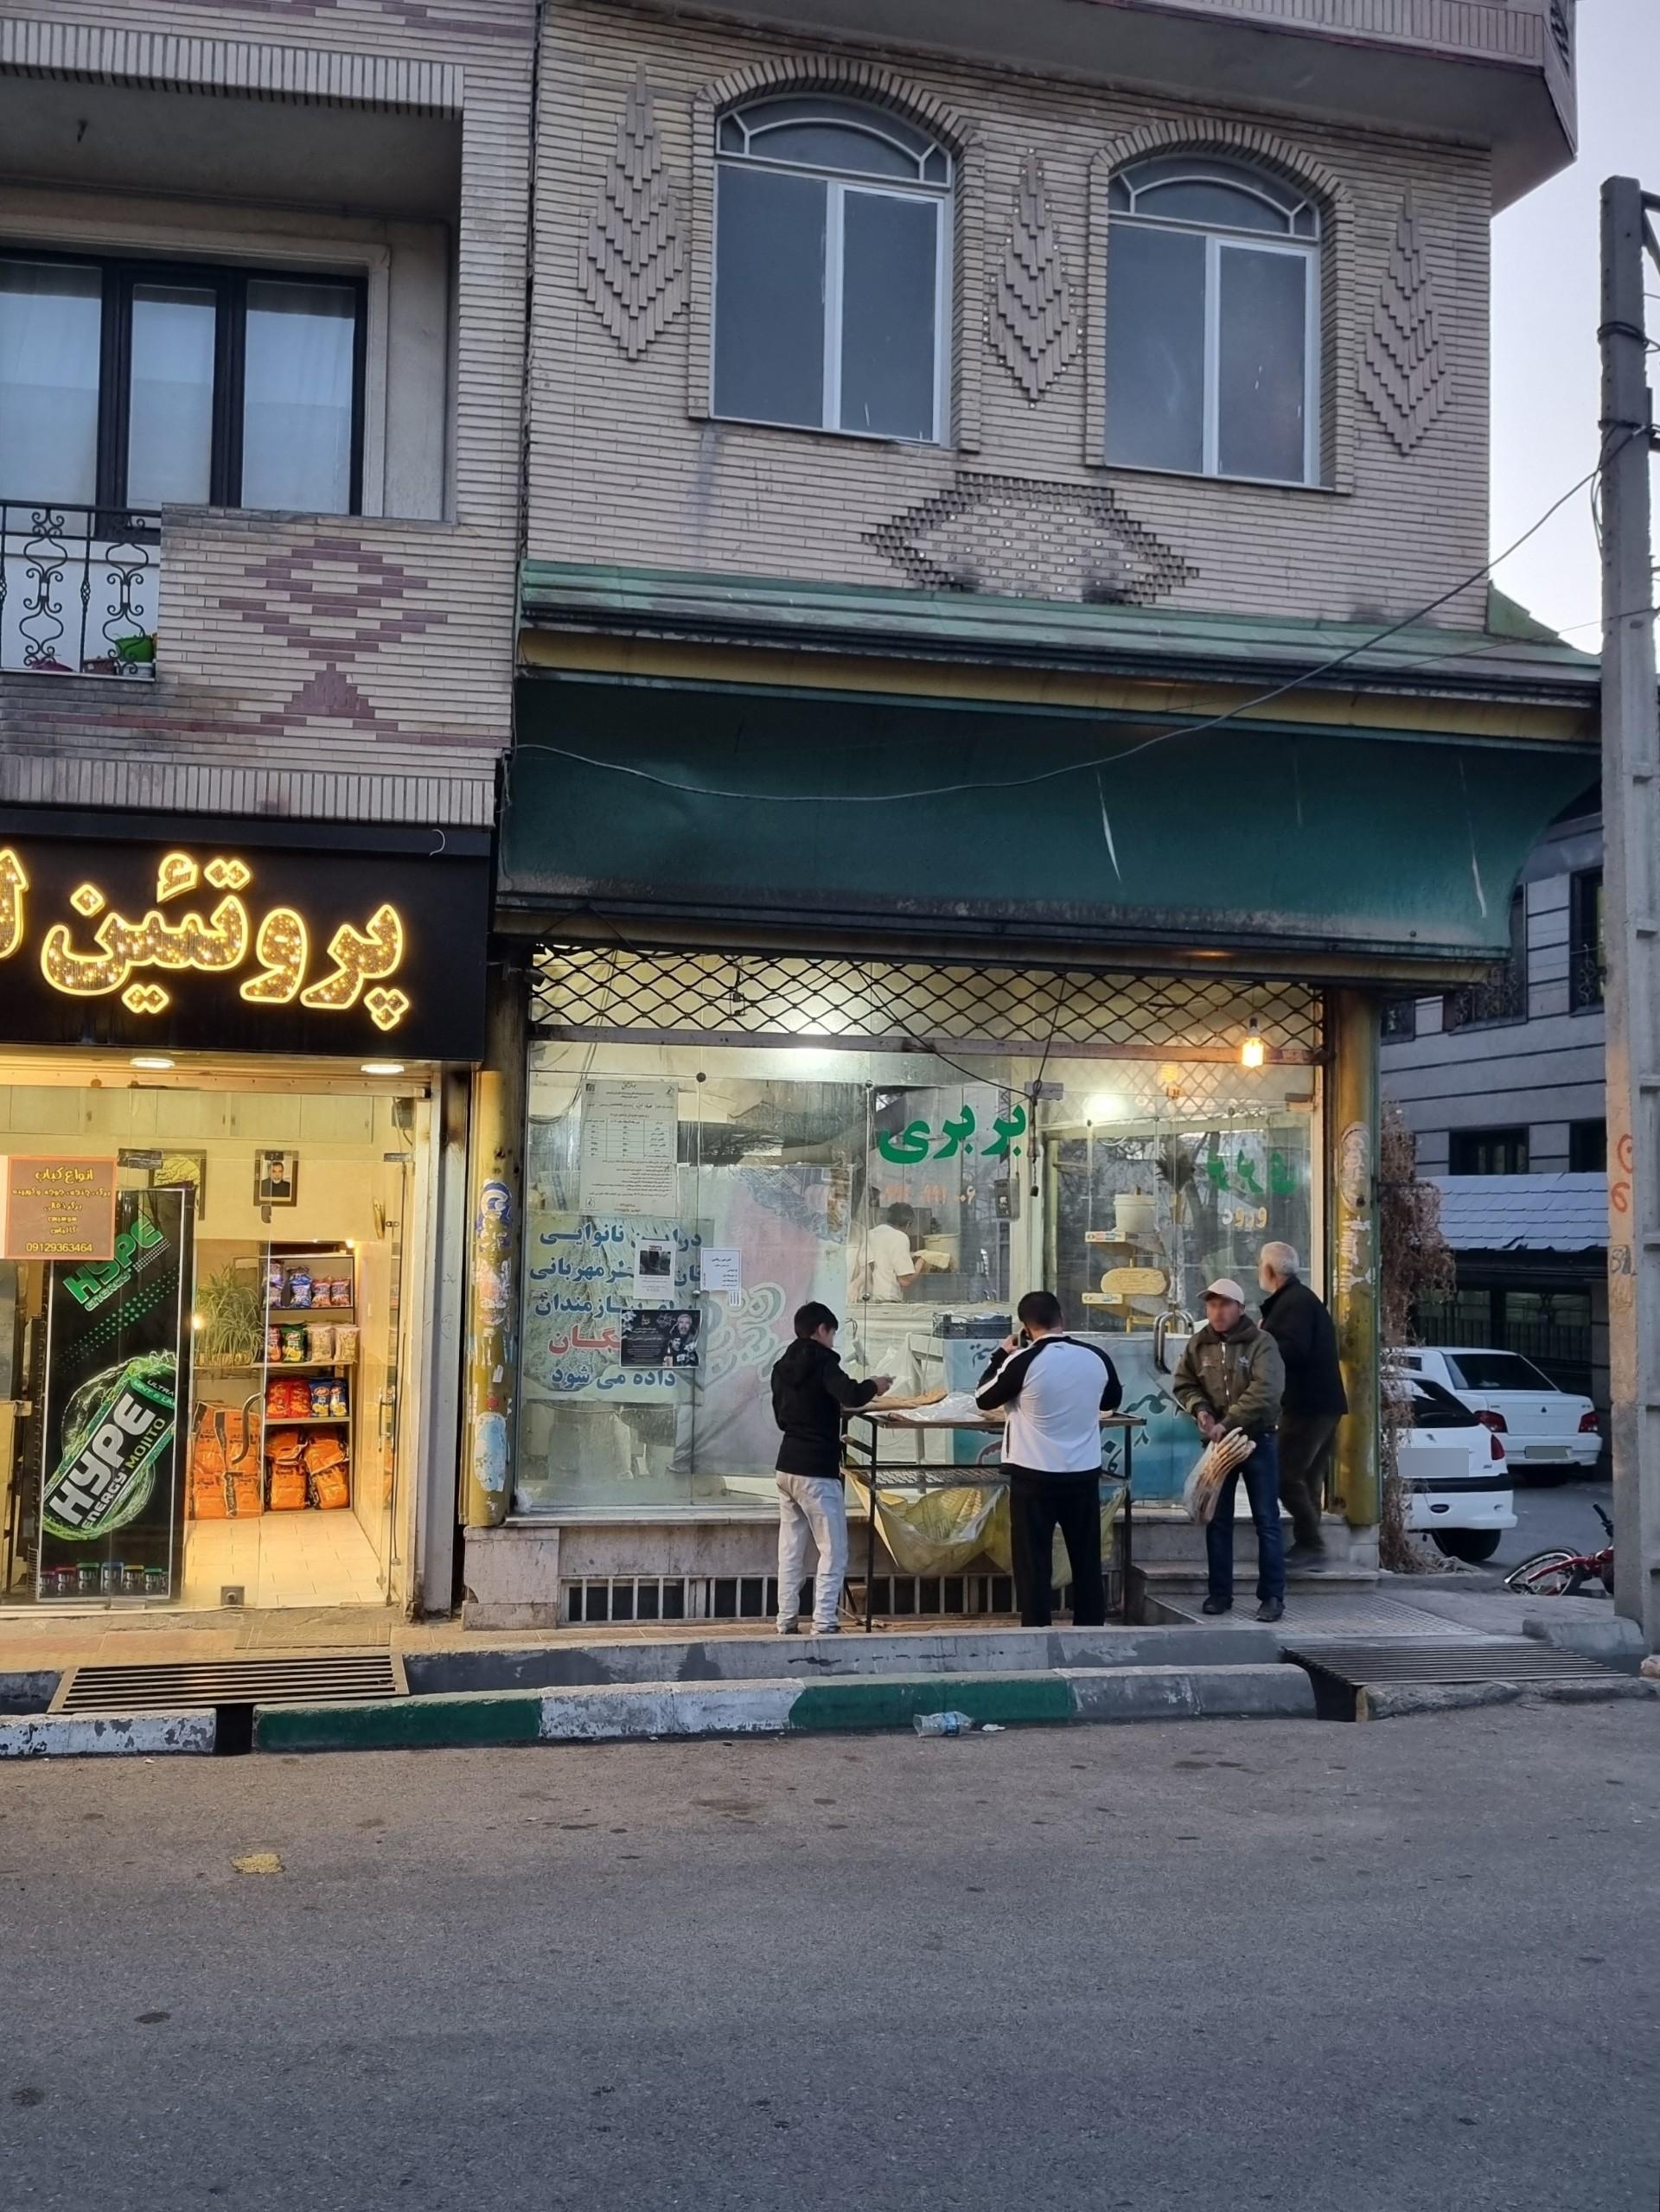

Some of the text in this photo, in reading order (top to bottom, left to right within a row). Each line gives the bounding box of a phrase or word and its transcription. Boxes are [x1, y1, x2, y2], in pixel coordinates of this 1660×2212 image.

[42, 852, 410, 1031] پروتئین
[879, 1105, 1026, 1164] بربری
[35, 1167, 93, 1183] انواع کباب
[26, 1242, 93, 1252] 09129363464
[540, 1224, 624, 1247] نانوایی
[62, 1220, 163, 1304] HYPE
[530, 1257, 604, 1283] مهربانی
[147, 1380, 175, 1397] ULTRA
[552, 1366, 676, 1390] داده می شود
[49, 1393, 155, 1527] HYPE
[80, 1417, 167, 1530] ENERGY MOJITO
